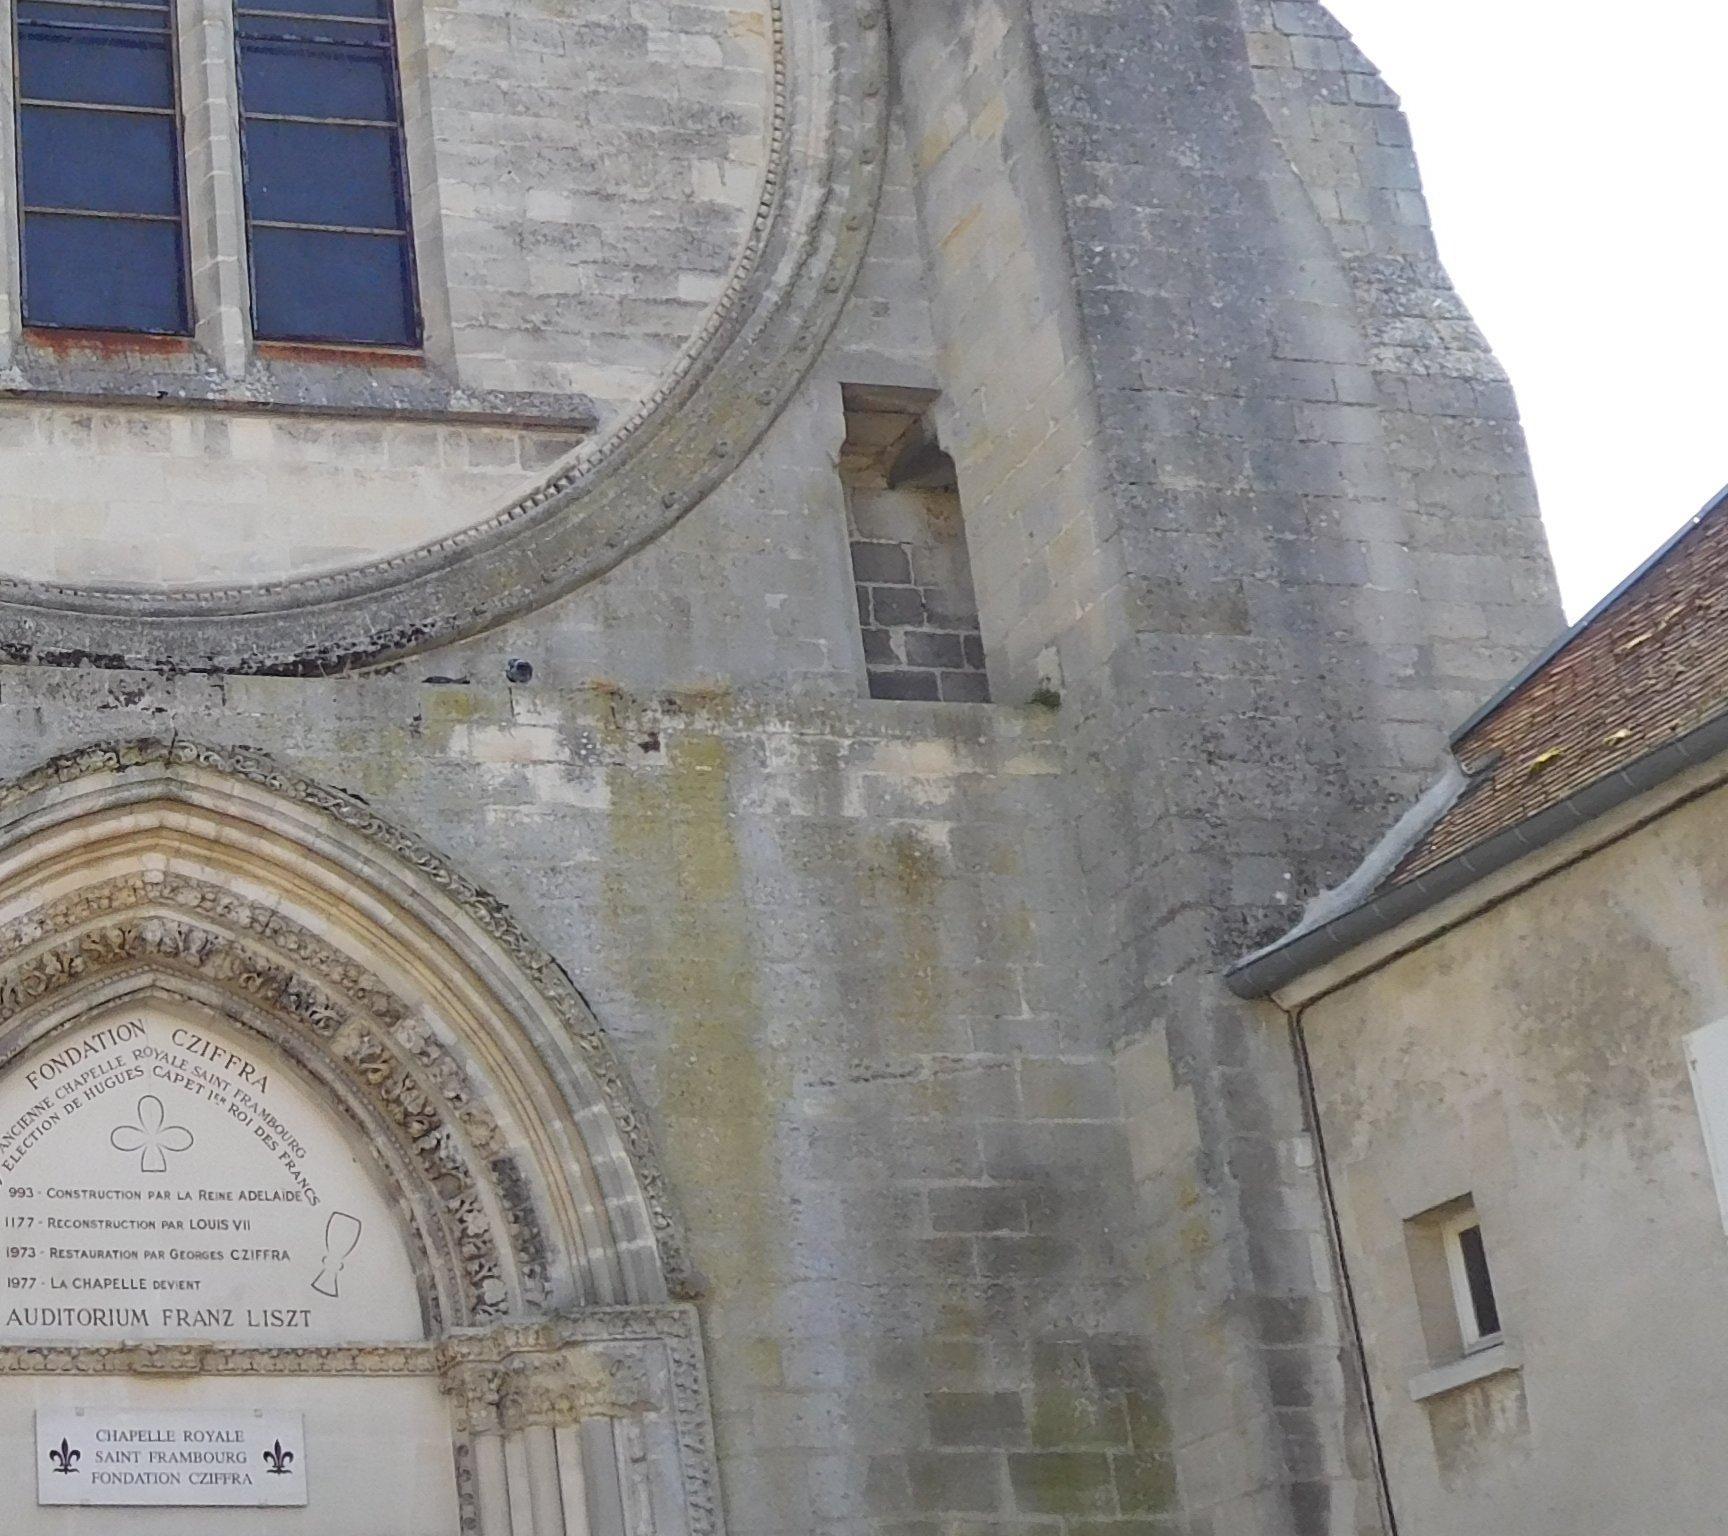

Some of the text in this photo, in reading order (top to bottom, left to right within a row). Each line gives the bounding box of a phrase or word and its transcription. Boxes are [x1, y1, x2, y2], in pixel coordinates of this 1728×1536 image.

[25, 1018, 268, 1094] FONDATION CZIFFRA
[55, 1055, 127, 1100] CHAPELLE
[132, 1046, 189, 1071] ROYALE
[192, 1063, 231, 1092] SAINT
[233, 1088, 307, 1159] FRAMBOURG
[2, 1113, 61, 1172] ELECTION
[63, 1097, 83, 1115] DE
[83, 1066, 145, 1101] HUGUES
[153, 1065, 205, 1095] CAPET
[227, 1102, 254, 1127] ROI
[254, 1125, 279, 1151] DES
[278, 1151, 321, 1207] FRANCS
[8, 1187, 34, 1198] 993
[148, 1190, 171, 1200] PAR
[5, 1217, 34, 1228] 1177
[161, 1220, 184, 1230] PAR
[189, 1218, 229, 1230] LOUIS
[232, 1219, 251, 1231] VII
[6, 1246, 36, 1258] 1973
[144, 1250, 165, 1260] PAR
[230, 1249, 291, 1261] CZIFFRA
[7, 1277, 37, 1288] 1977
[72, 1277, 147, 1290] CHAPELLE
[153, 1280, 201, 1290] DEVIENT
[6, 1308, 311, 1328] AUDITORIUM FRANZ LISZT
[95, 1429, 245, 1443] CHAPELLE ROYALE
[95, 1450, 247, 1464] SAINT FRAMBOURG
[91, 1471, 253, 1485] FONDATION CZIFFRA
